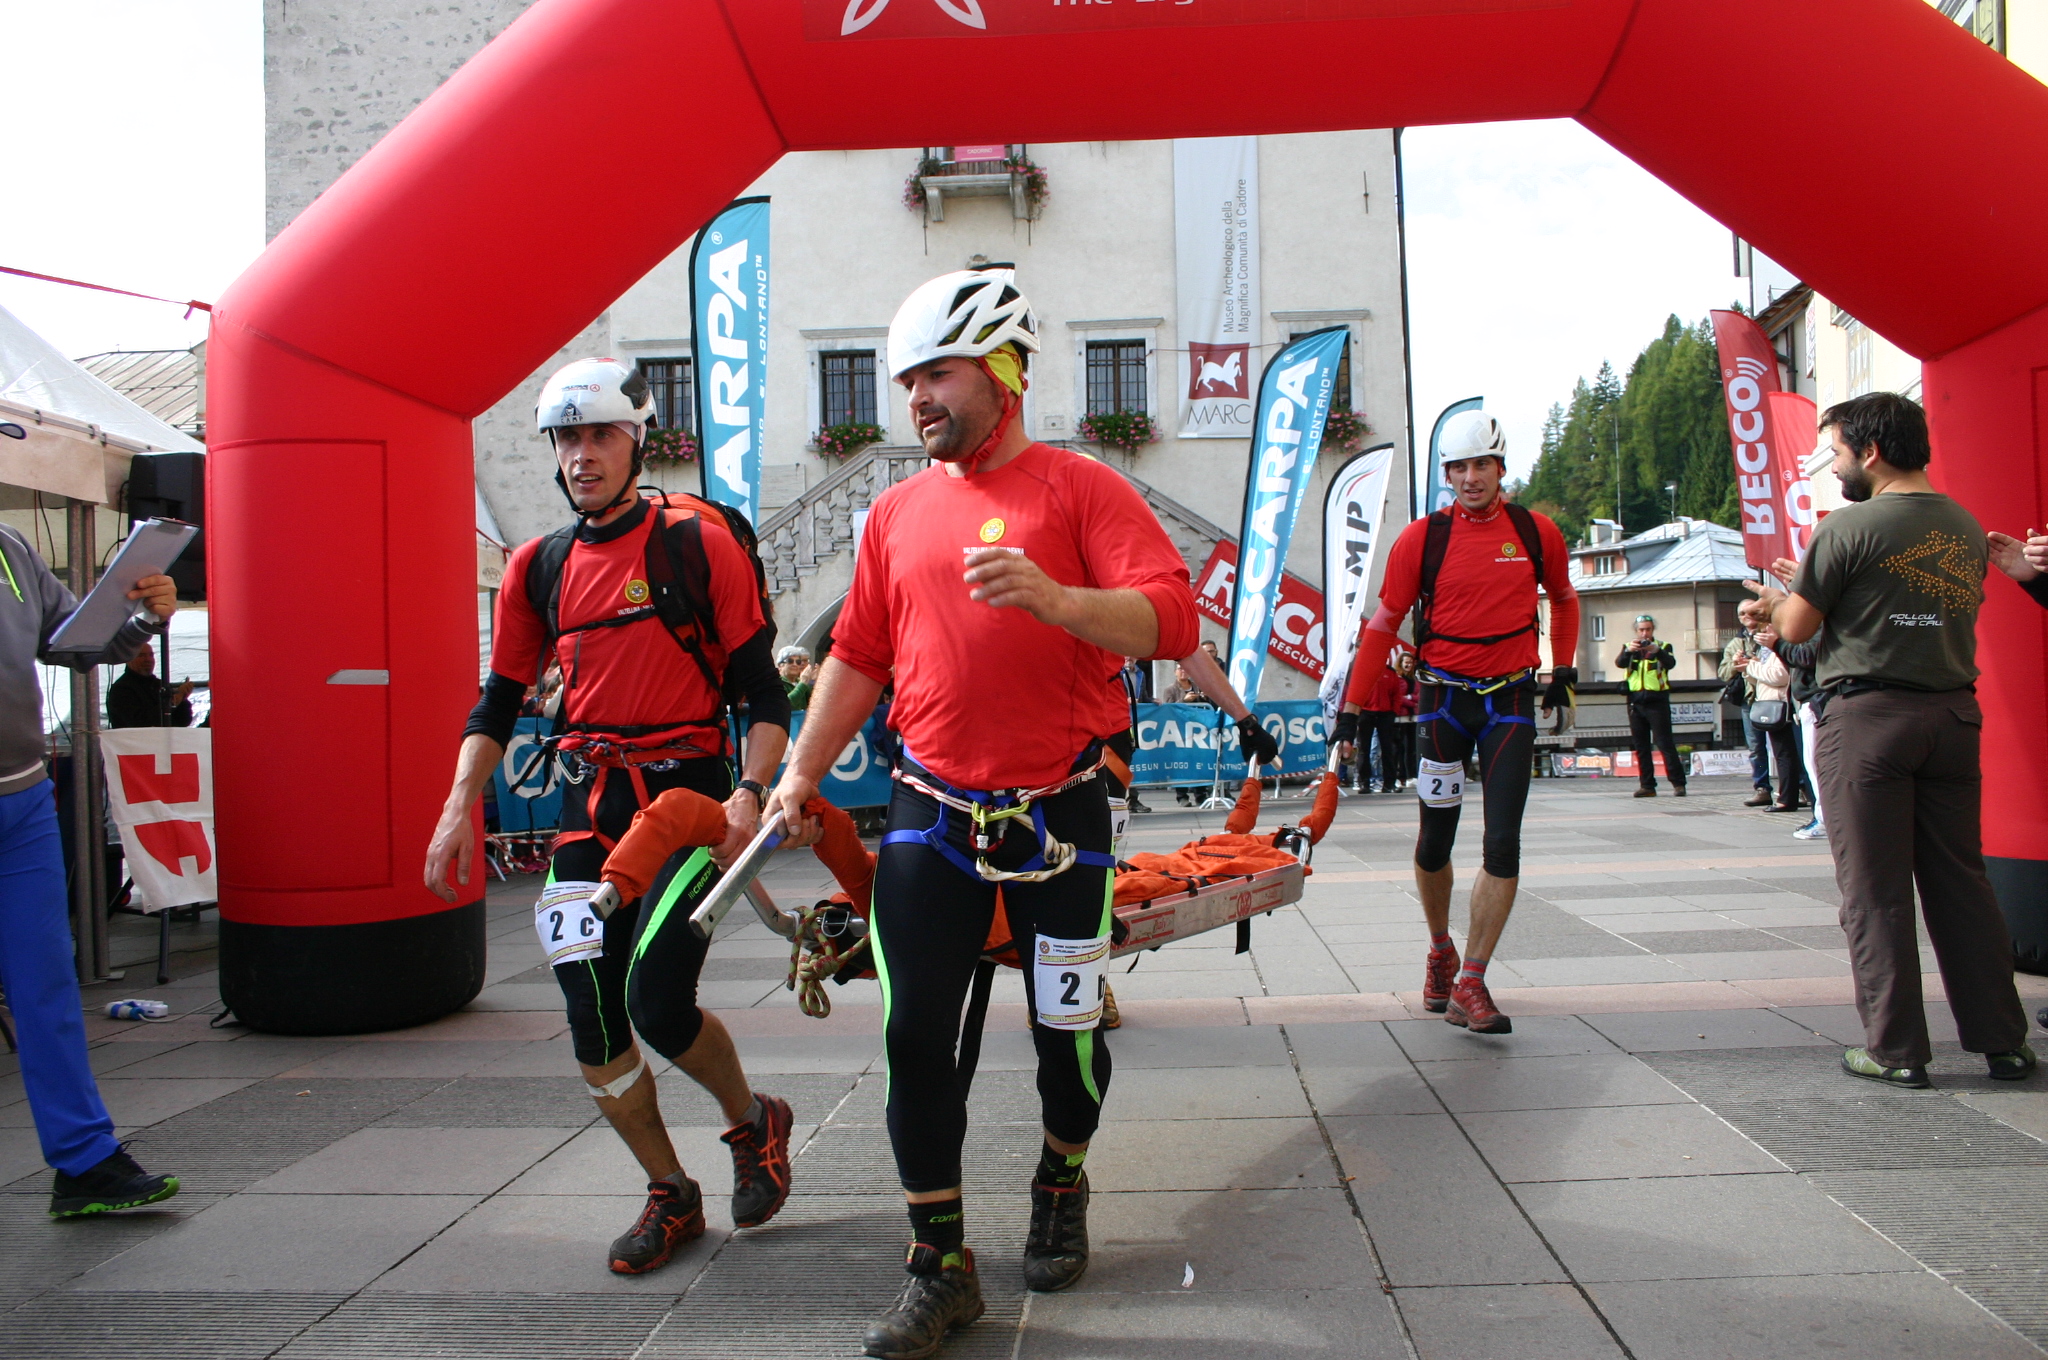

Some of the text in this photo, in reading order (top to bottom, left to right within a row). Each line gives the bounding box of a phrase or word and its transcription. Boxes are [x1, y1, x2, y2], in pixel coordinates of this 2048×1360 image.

[1236, 178, 1252, 333] Magnifica Comunità di Cadore
[1221, 200, 1236, 333] Museo Archeologico della
[1888, 613, 1937, 621] FOLLOW
[1893, 619, 1917, 627] THE
[1268, 637, 1316, 671] RESCUE
[1713, 752, 1743, 760] OTTICA
[1129, 762, 1159, 773] ESSUN
[1431, 778, 1460, 796] 2 a
[1116, 819, 1126, 834] d
[549, 910, 595, 942] 2 c
[1060, 971, 1081, 1006] 2
